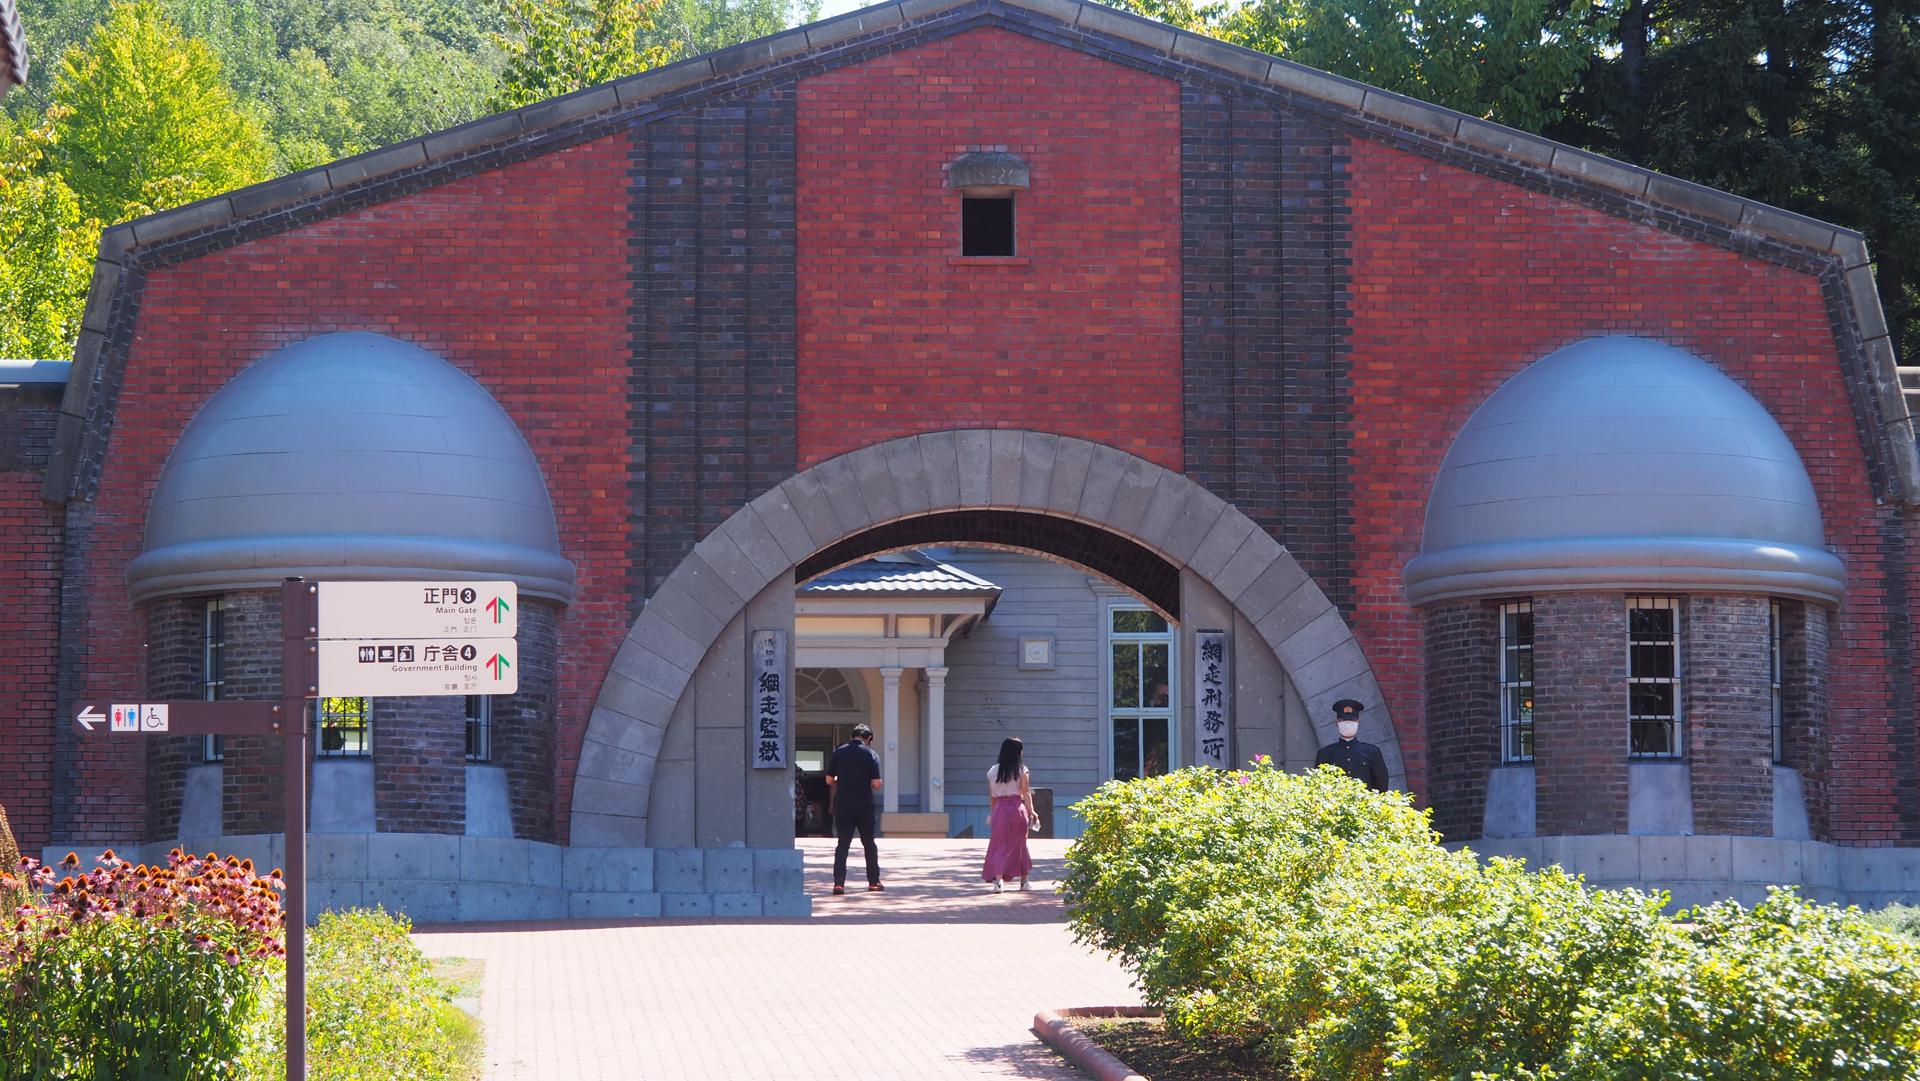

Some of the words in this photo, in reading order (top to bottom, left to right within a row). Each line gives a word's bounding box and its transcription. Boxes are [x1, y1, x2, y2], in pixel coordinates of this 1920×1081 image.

[424, 588, 458, 604] 正門
[424, 645, 458, 661] 庁舎
[444, 664, 478, 672] Building
